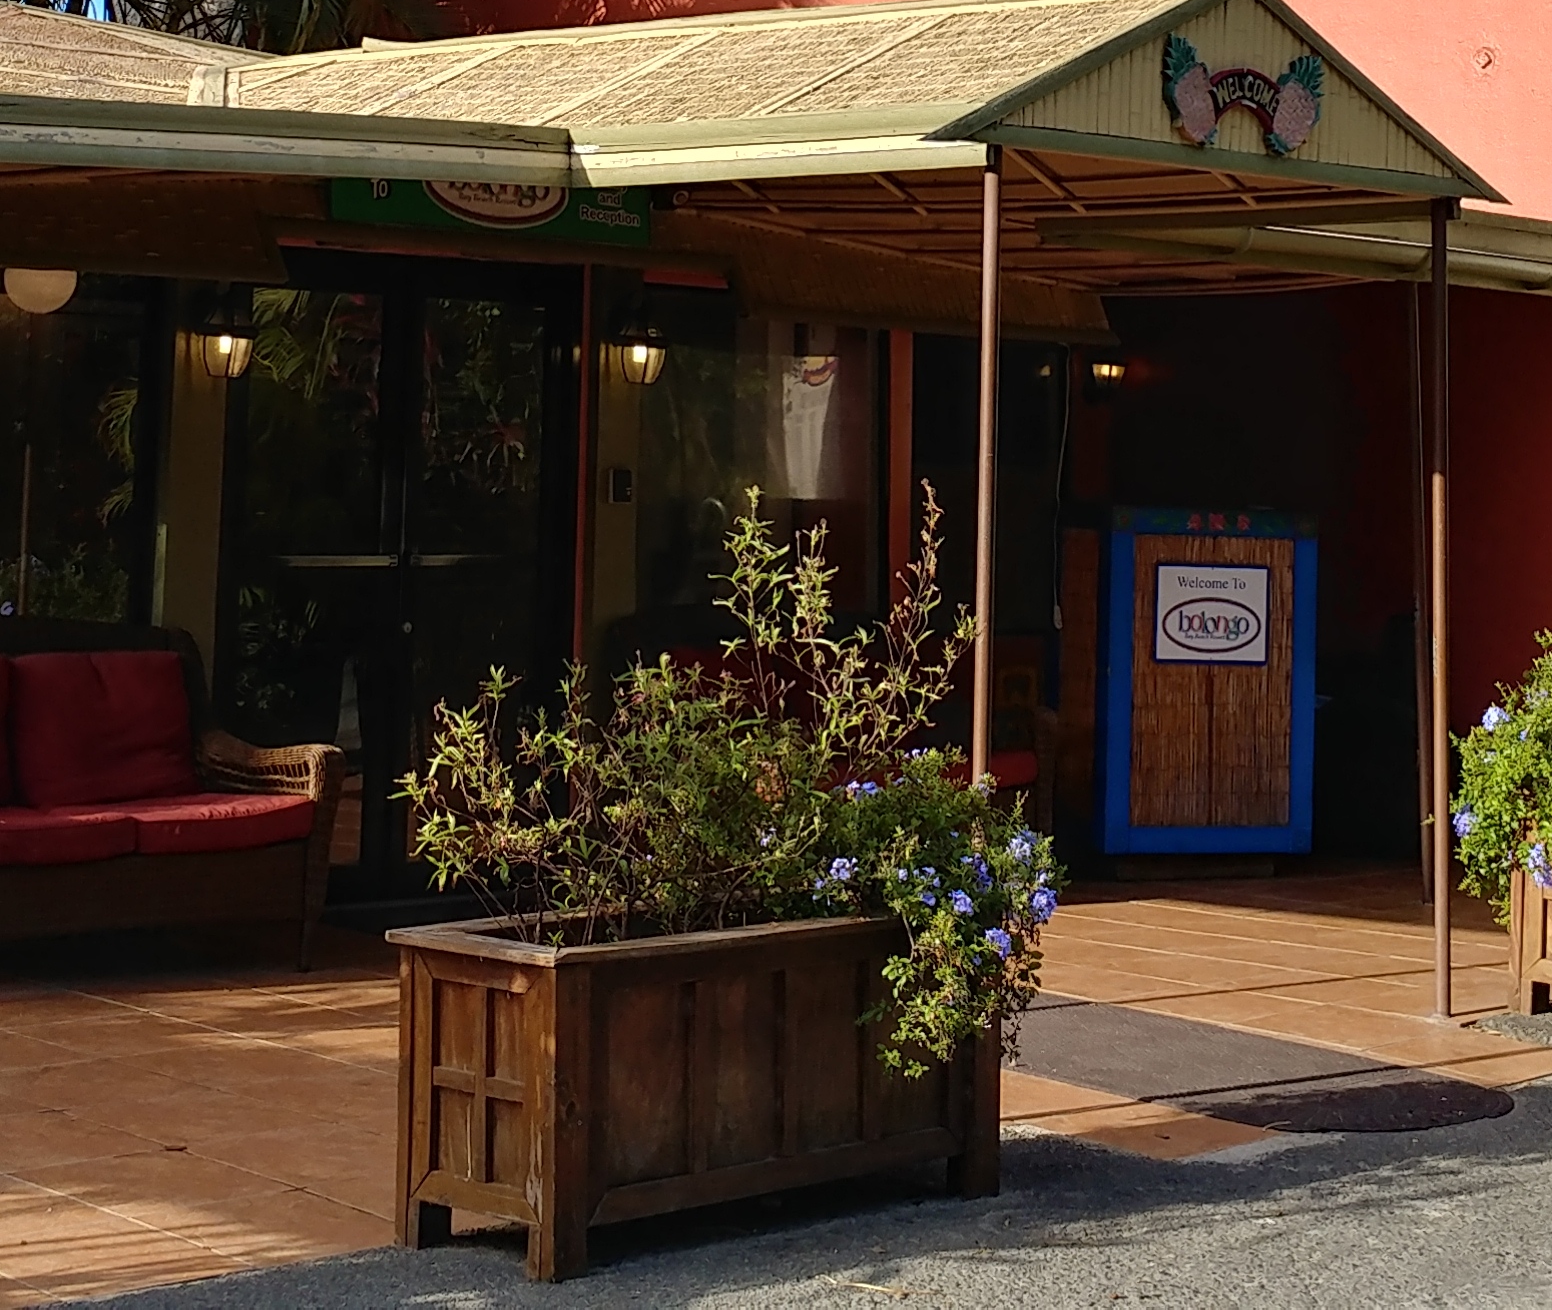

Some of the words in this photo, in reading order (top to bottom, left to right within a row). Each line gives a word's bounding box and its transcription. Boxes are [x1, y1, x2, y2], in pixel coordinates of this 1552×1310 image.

[1213, 75, 1280, 116] WELCOME
[599, 192, 621, 206] and
[580, 204, 640, 226] Reception
[1177, 575, 1229, 589] Welcome
[1232, 577, 1246, 590] To
[1178, 609, 1250, 641] bolongo
